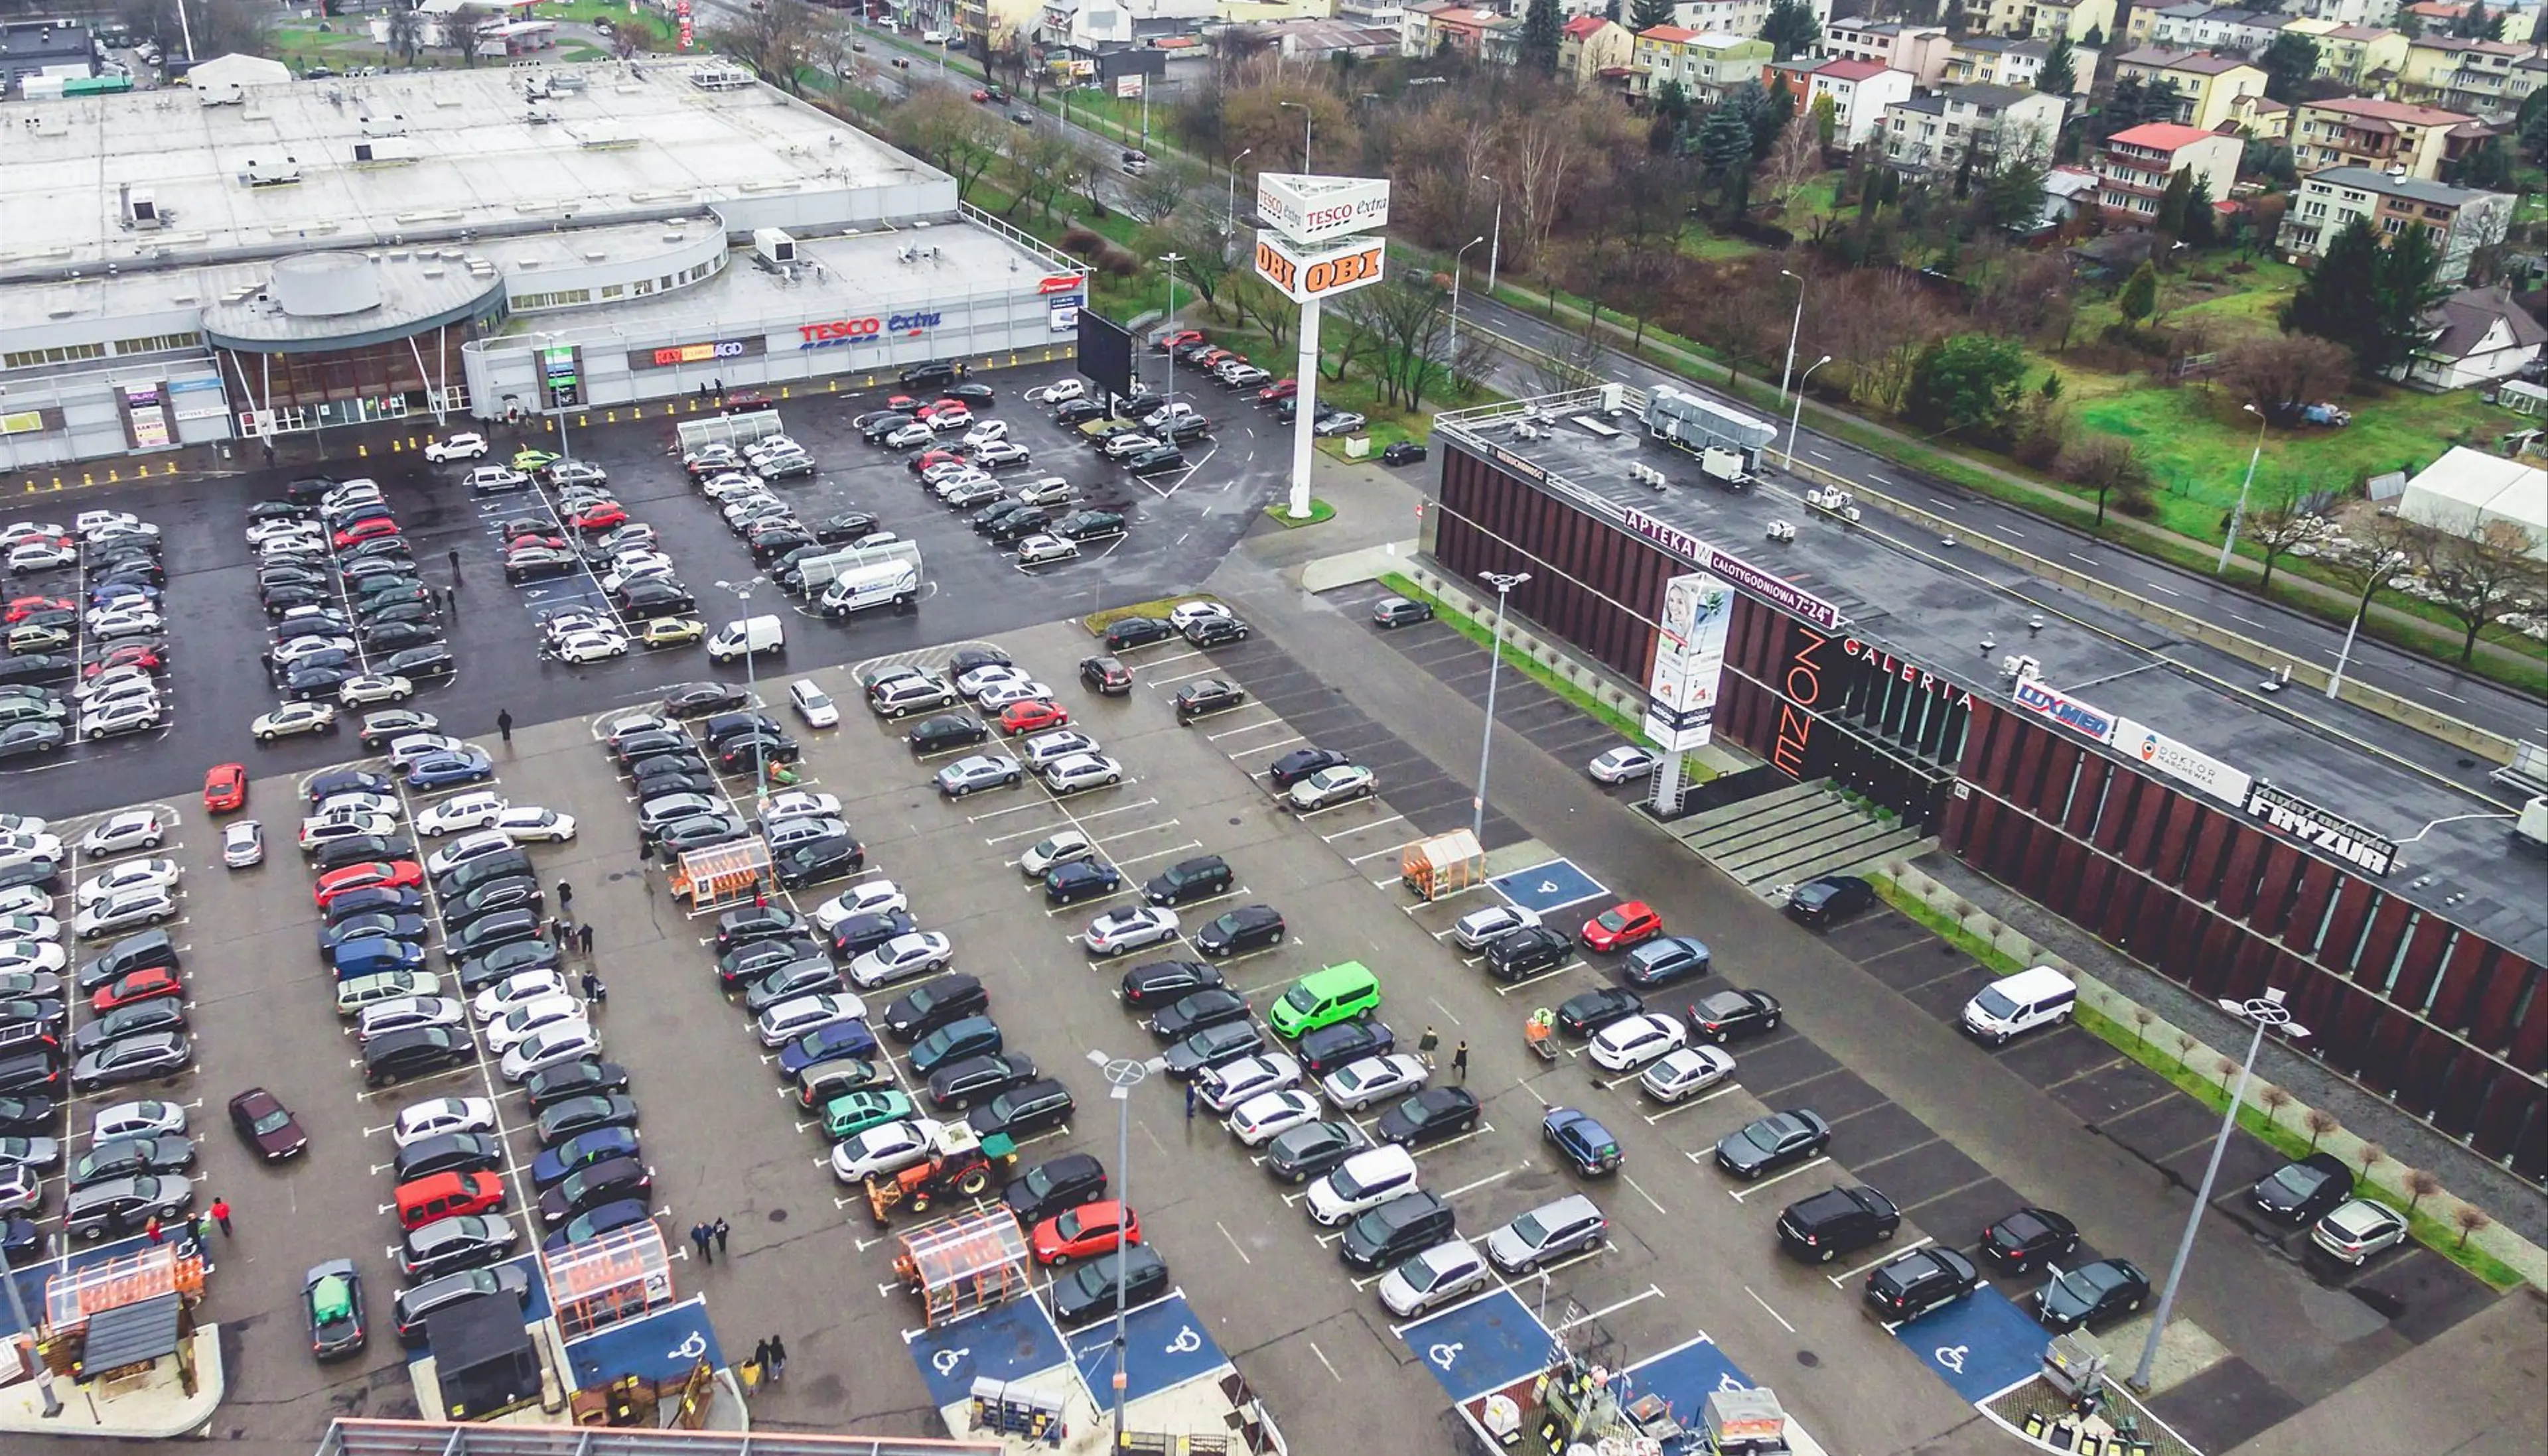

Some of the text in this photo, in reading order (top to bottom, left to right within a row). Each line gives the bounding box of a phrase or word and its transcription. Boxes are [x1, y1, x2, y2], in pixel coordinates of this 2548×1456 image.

[1259, 188, 1301, 227] TESCO extra
[1307, 195, 1387, 226] TESCO extra
[1256, 243, 1296, 293] OBI
[1306, 248, 1381, 293] OBI
[798, 311, 942, 342] TESCO extra
[714, 342, 743, 357] AGD
[129, 392, 155, 401] PLAY
[1626, 513, 1693, 557] APTEKA
[1713, 557, 1795, 604] CAŁOTYGODNIOWA
[1844, 638, 1973, 712] GALERIA
[1773, 628, 1826, 777] ZONE
[2157, 755, 2214, 786] MARCHEWKA
[2160, 746, 2216, 777] DOKTOR
[2247, 794, 2389, 876] FRYZUR
